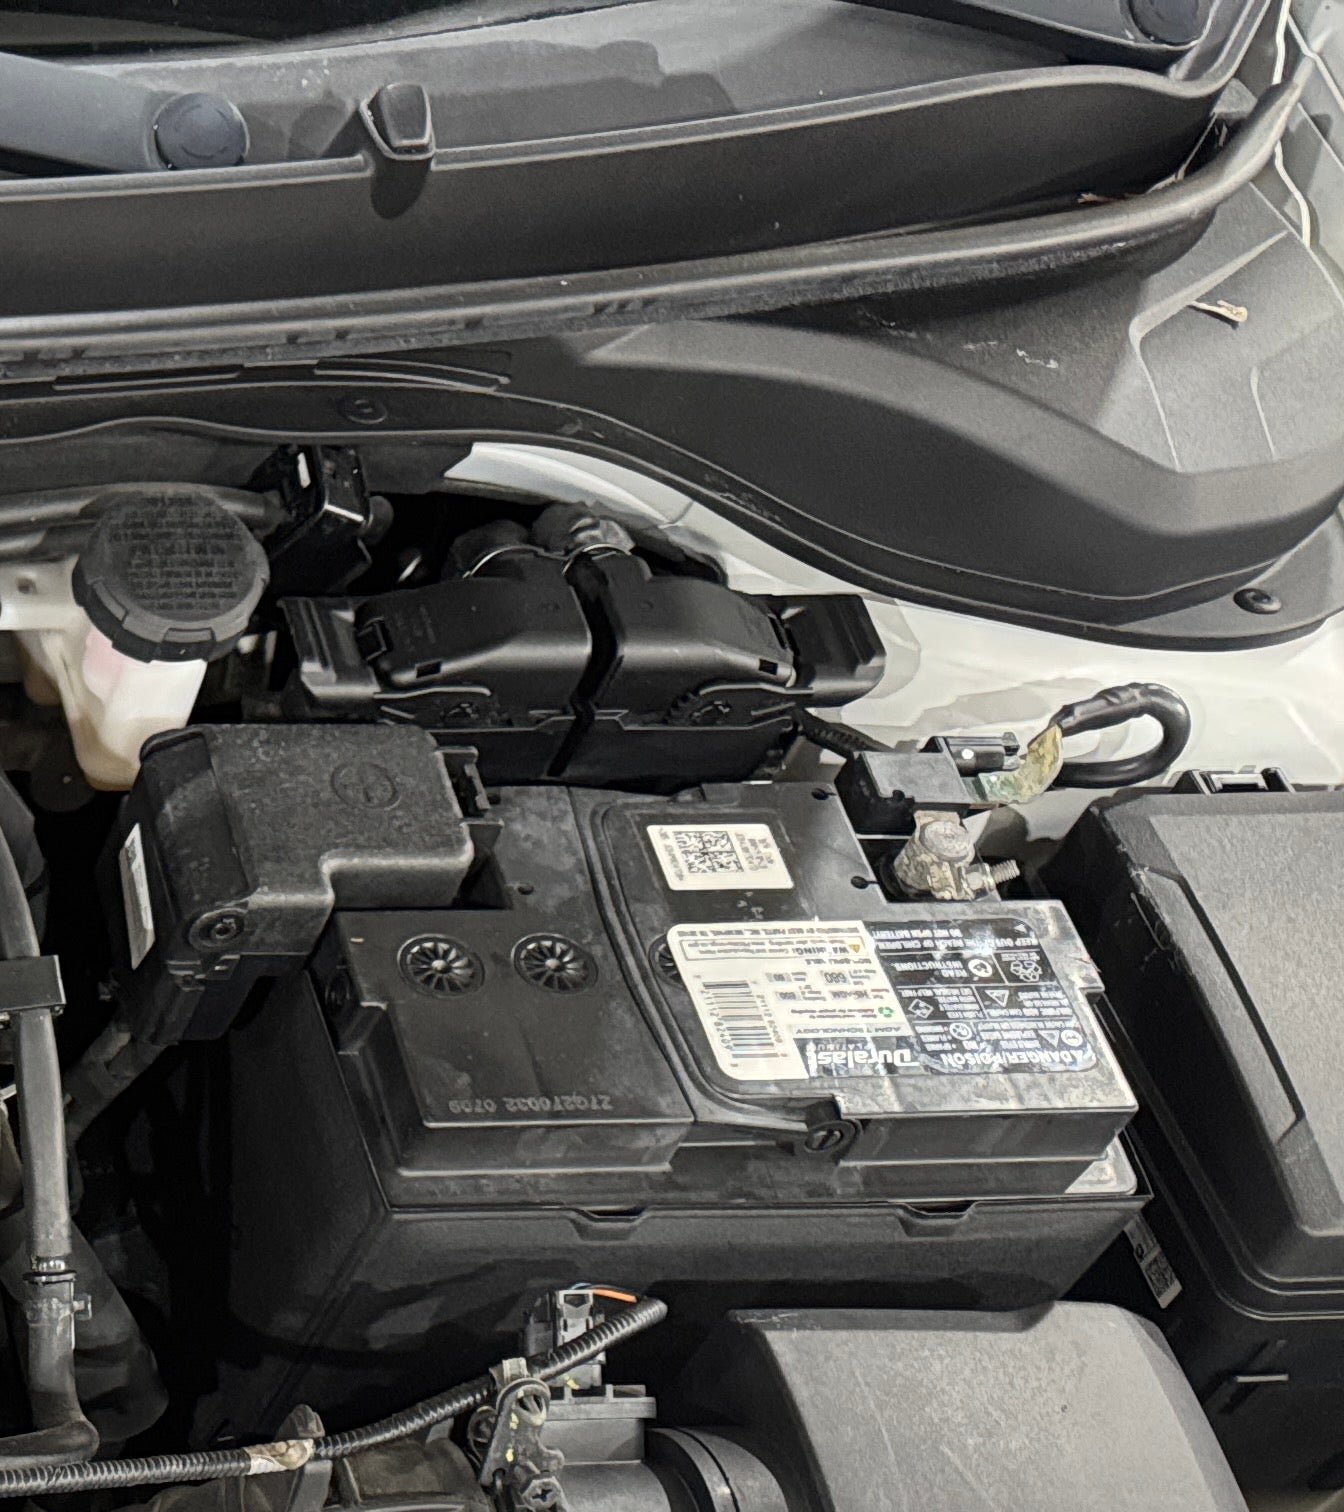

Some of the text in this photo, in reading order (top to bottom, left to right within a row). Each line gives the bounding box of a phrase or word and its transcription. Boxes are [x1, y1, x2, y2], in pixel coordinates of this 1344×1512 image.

[823, 972, 847, 984] 680
[940, 969, 969, 978] READ
[807, 1048, 920, 1069] Duralast
